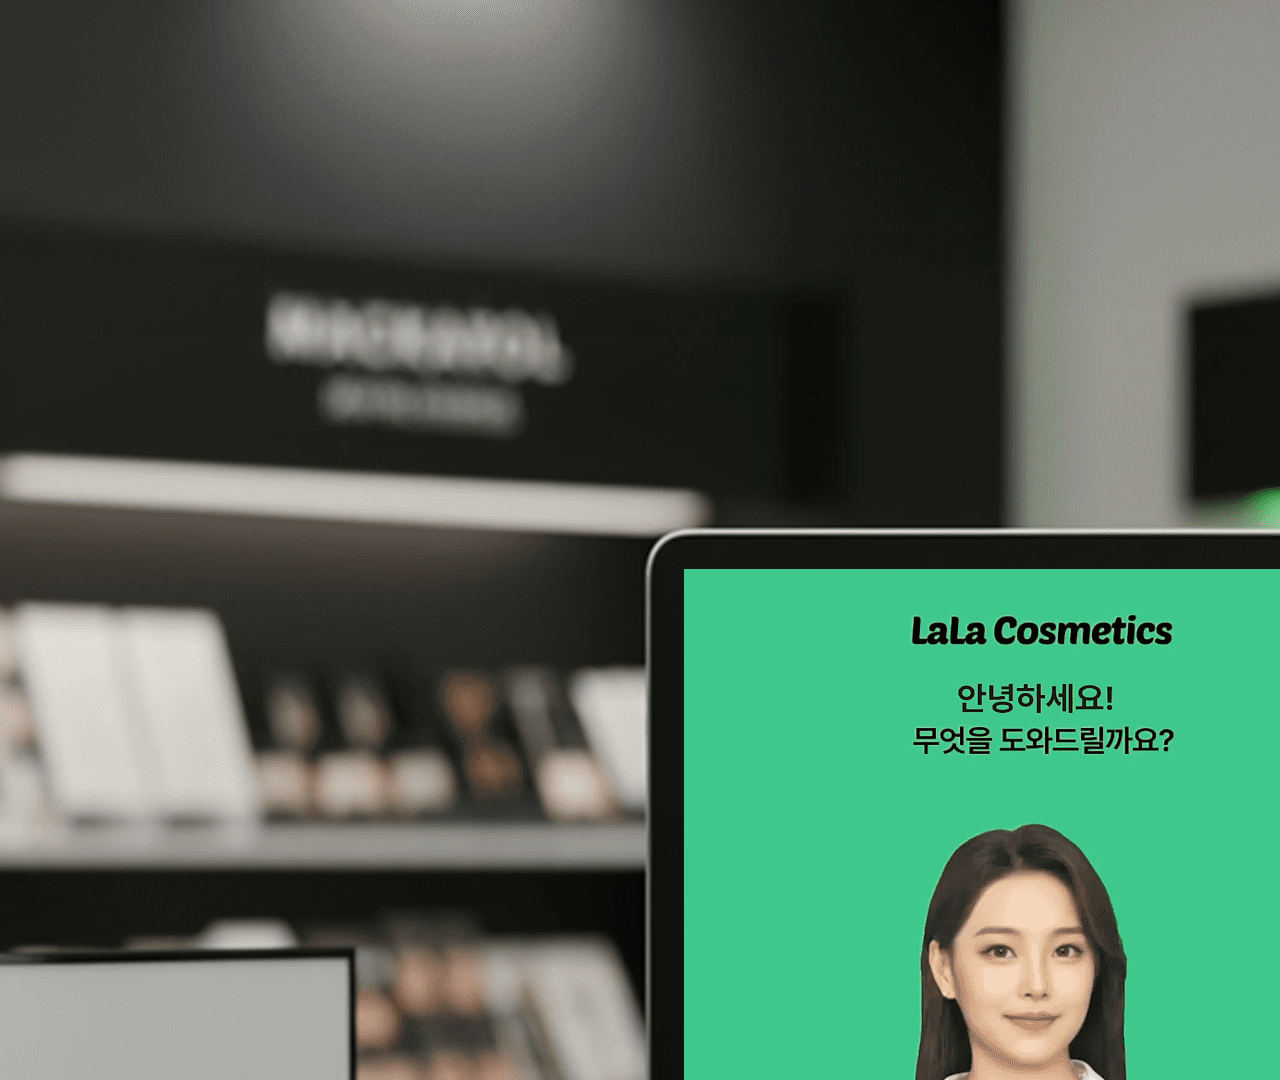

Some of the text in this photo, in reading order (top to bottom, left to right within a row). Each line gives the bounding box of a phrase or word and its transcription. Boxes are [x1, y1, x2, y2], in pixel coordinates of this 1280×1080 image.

[912, 615, 1172, 644] LaLa Cosmetics
[958, 684, 1112, 713] 안녕하세요!
[913, 726, 1174, 754] 무엇을 도와드릴까요?
